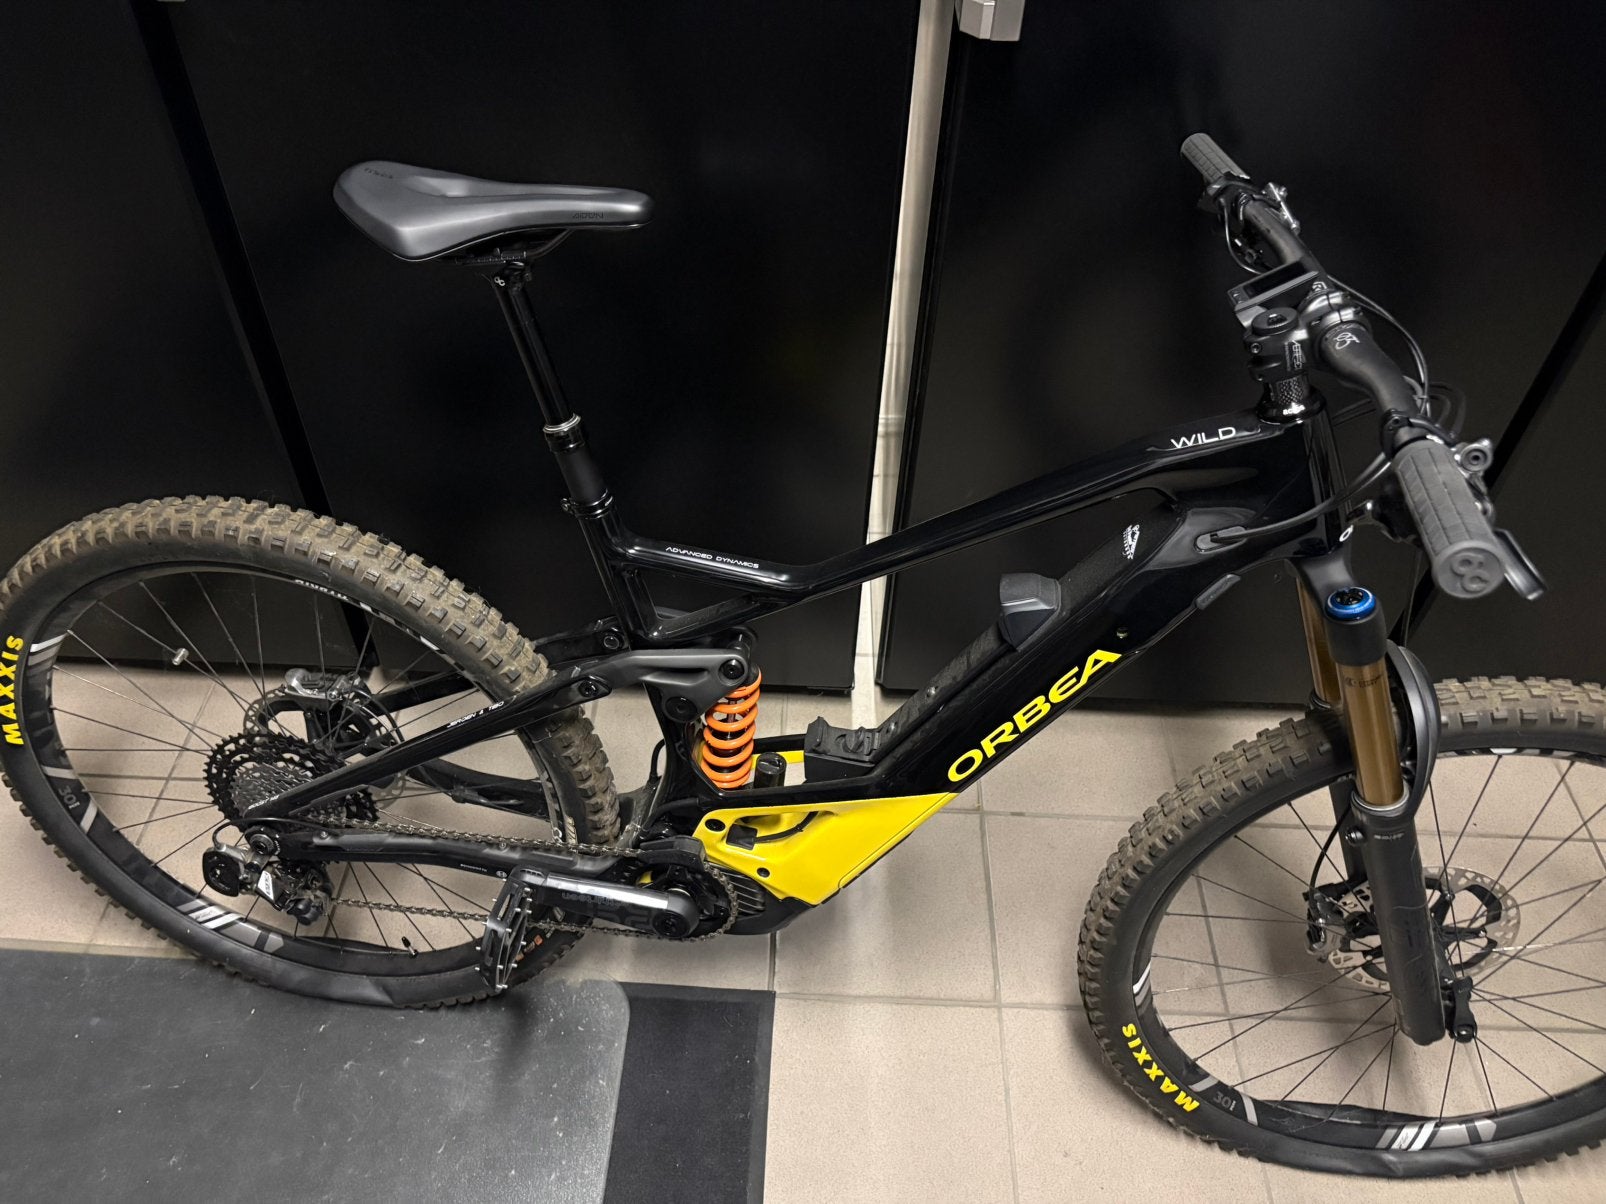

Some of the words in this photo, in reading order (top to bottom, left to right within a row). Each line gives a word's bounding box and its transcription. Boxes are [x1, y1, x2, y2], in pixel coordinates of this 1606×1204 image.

[1170, 426, 1236, 448] WILD
[665, 546, 713, 560] ADVANCED
[715, 556, 759, 569] DYNAMICS
[0, 635, 24, 745] MAXXIS
[947, 649, 1122, 782] ORBEA
[1122, 1023, 1200, 1112] MAXXIS
